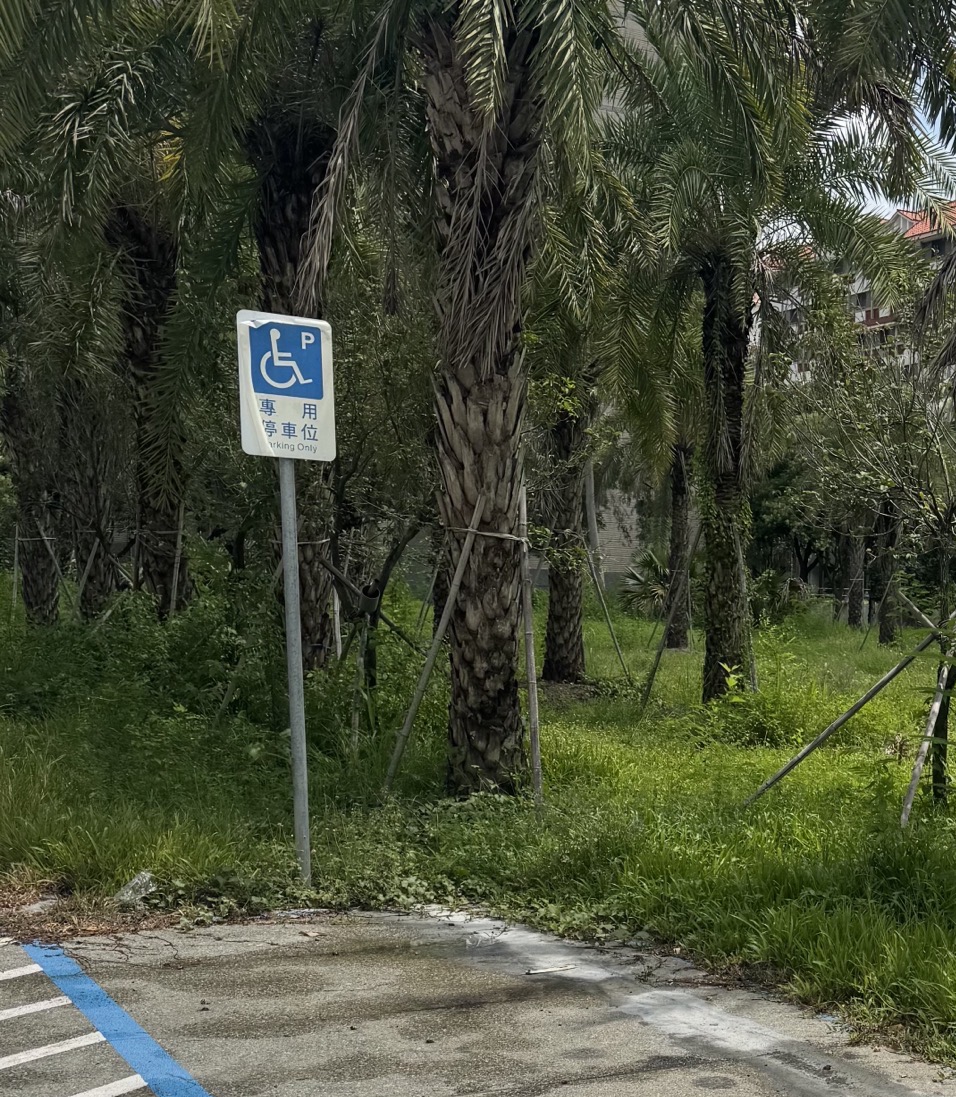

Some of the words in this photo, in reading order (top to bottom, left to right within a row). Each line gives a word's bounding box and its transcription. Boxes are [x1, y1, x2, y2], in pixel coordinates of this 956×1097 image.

[301, 331, 315, 350] P
[262, 419, 319, 442] 停車位
[269, 441, 295, 452] arking
[297, 443, 318, 454] Only
